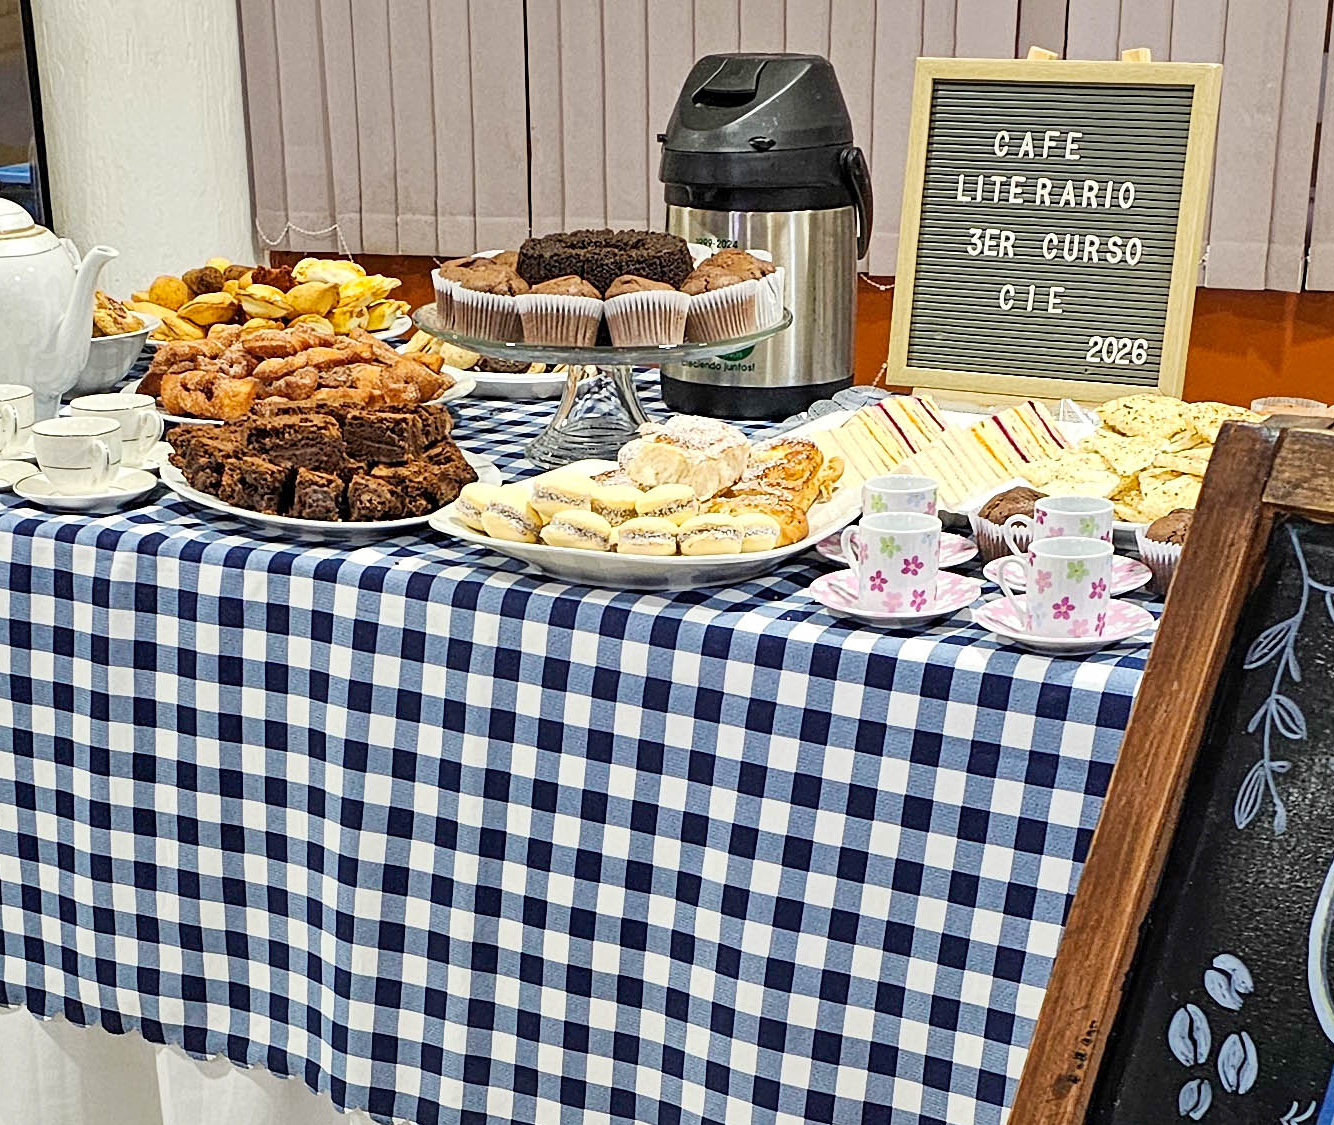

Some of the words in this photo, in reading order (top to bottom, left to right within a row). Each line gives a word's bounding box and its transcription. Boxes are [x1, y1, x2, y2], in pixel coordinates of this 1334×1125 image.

[994, 130, 1083, 160] CAFE
[956, 174, 1136, 209] LITERARIO
[967, 227, 1015, 259] 3ER
[1042, 232, 1142, 266] CURSO
[999, 284, 1066, 314] CIE
[1085, 336, 1148, 366] 2026
